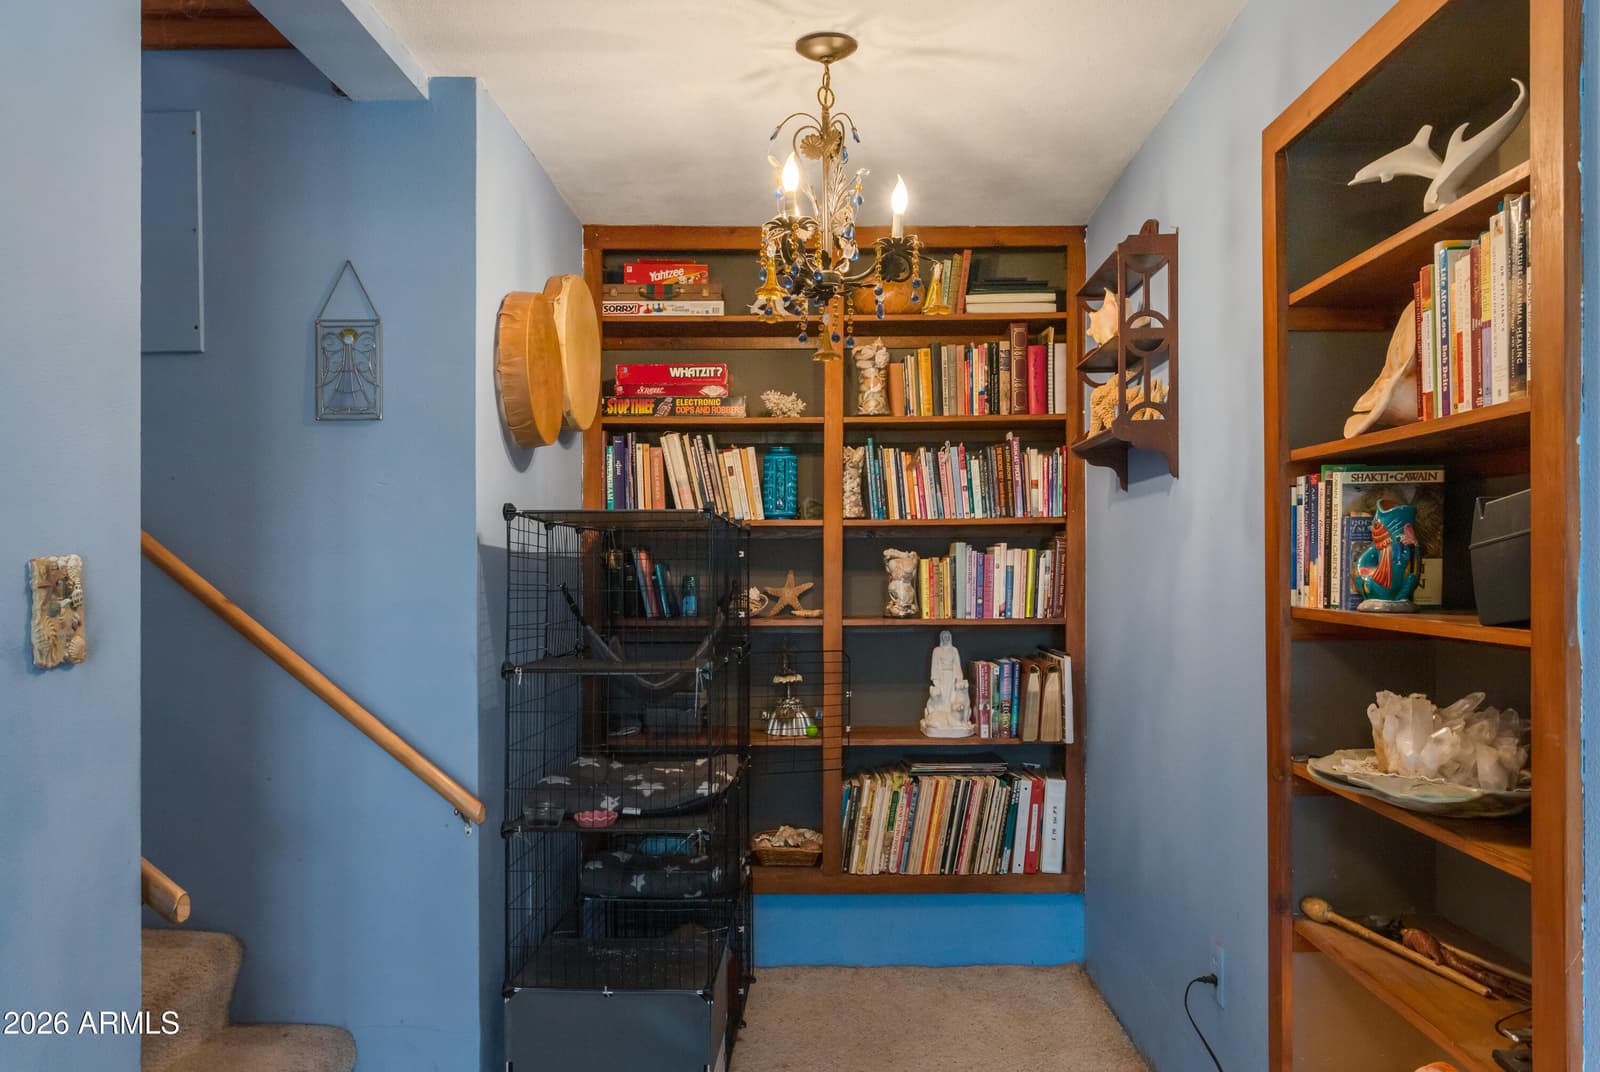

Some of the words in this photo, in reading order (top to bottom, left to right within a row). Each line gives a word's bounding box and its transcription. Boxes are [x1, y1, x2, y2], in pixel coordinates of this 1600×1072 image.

[649, 268, 684, 282] Yahtzee
[1517, 278, 1523, 289] OF
[604, 304, 638, 313] SORRY!
[670, 367, 722, 378] WHATZIT?
[608, 400, 630, 414] STOP
[631, 399, 654, 414] THIEF
[676, 406, 696, 414] COPS
[696, 406, 710, 414] AND
[712, 406, 744, 414] ROBBERS
[1351, 473, 1390, 482] SHAKTI
[1394, 472, 1438, 482] GAWAIN
